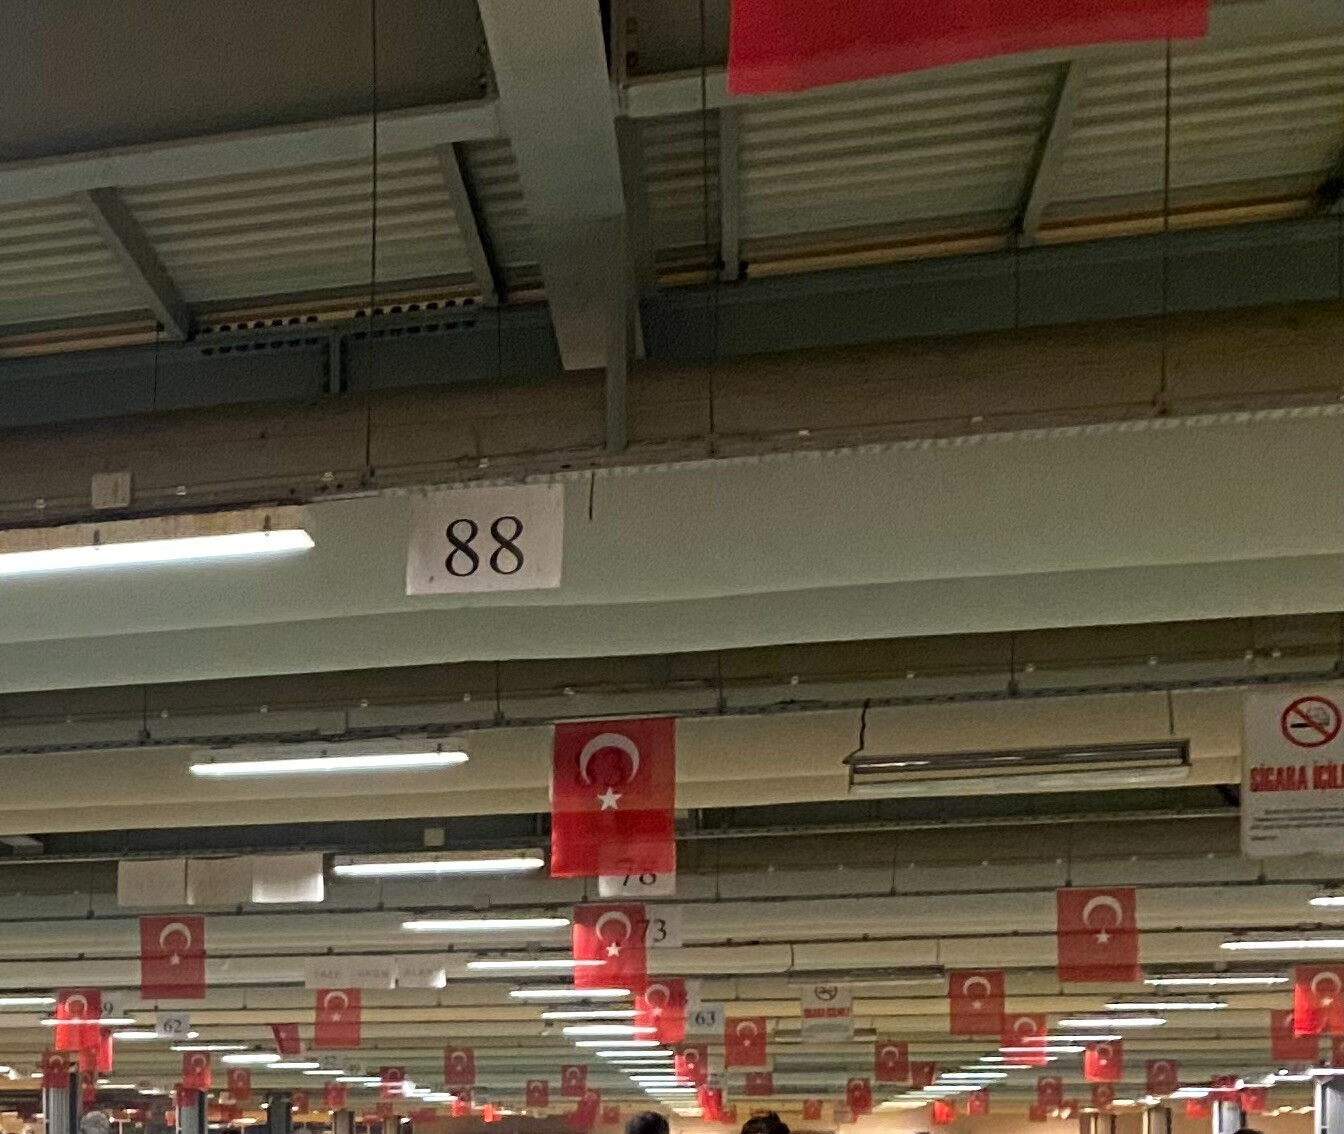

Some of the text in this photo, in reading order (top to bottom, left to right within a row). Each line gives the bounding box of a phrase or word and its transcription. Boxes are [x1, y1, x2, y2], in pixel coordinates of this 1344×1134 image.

[445, 516, 524, 577] 88
[695, 1011, 716, 1025] 63
[163, 1019, 182, 1033] 62
